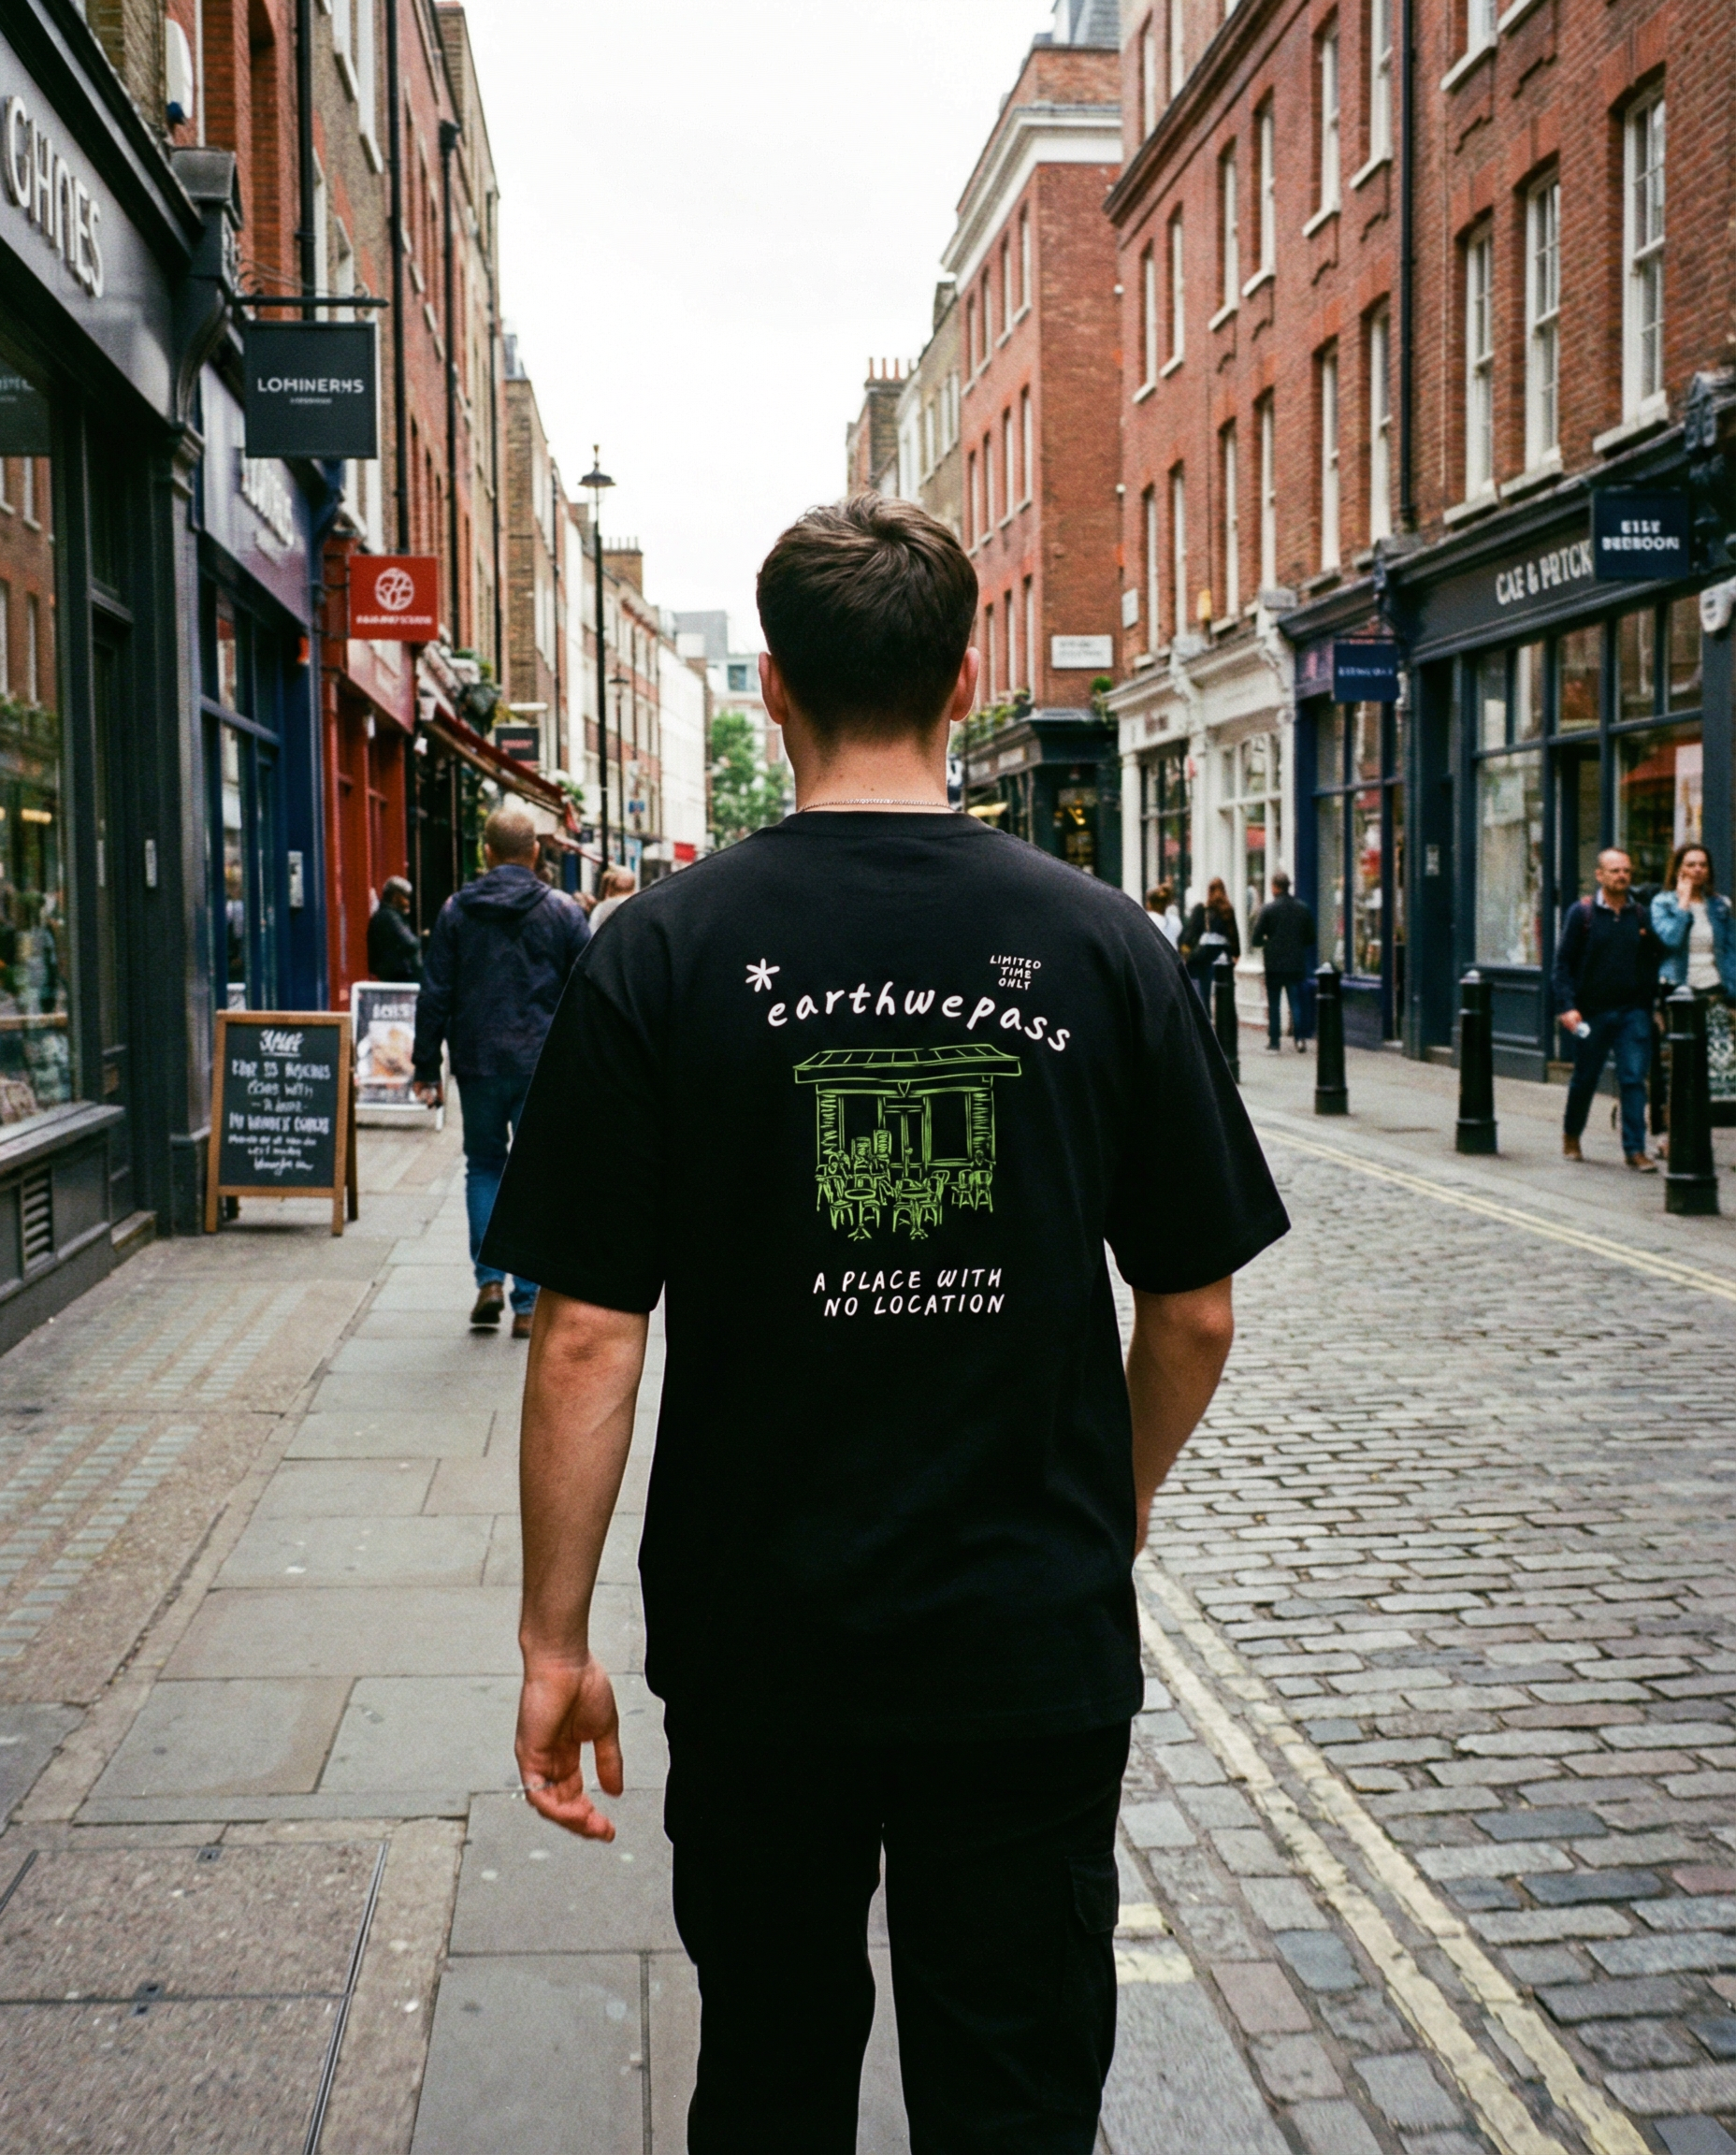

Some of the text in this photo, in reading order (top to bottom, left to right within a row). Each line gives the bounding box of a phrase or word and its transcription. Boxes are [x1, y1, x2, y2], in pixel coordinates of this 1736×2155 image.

[990, 954, 1042, 970] LIMITED
[1000, 966, 1032, 979] TIME
[767, 980, 1072, 1052] earthwepass
[813, 1267, 1003, 1294] A PLACE WITH
[823, 1294, 1005, 1317] NO LOCATION
